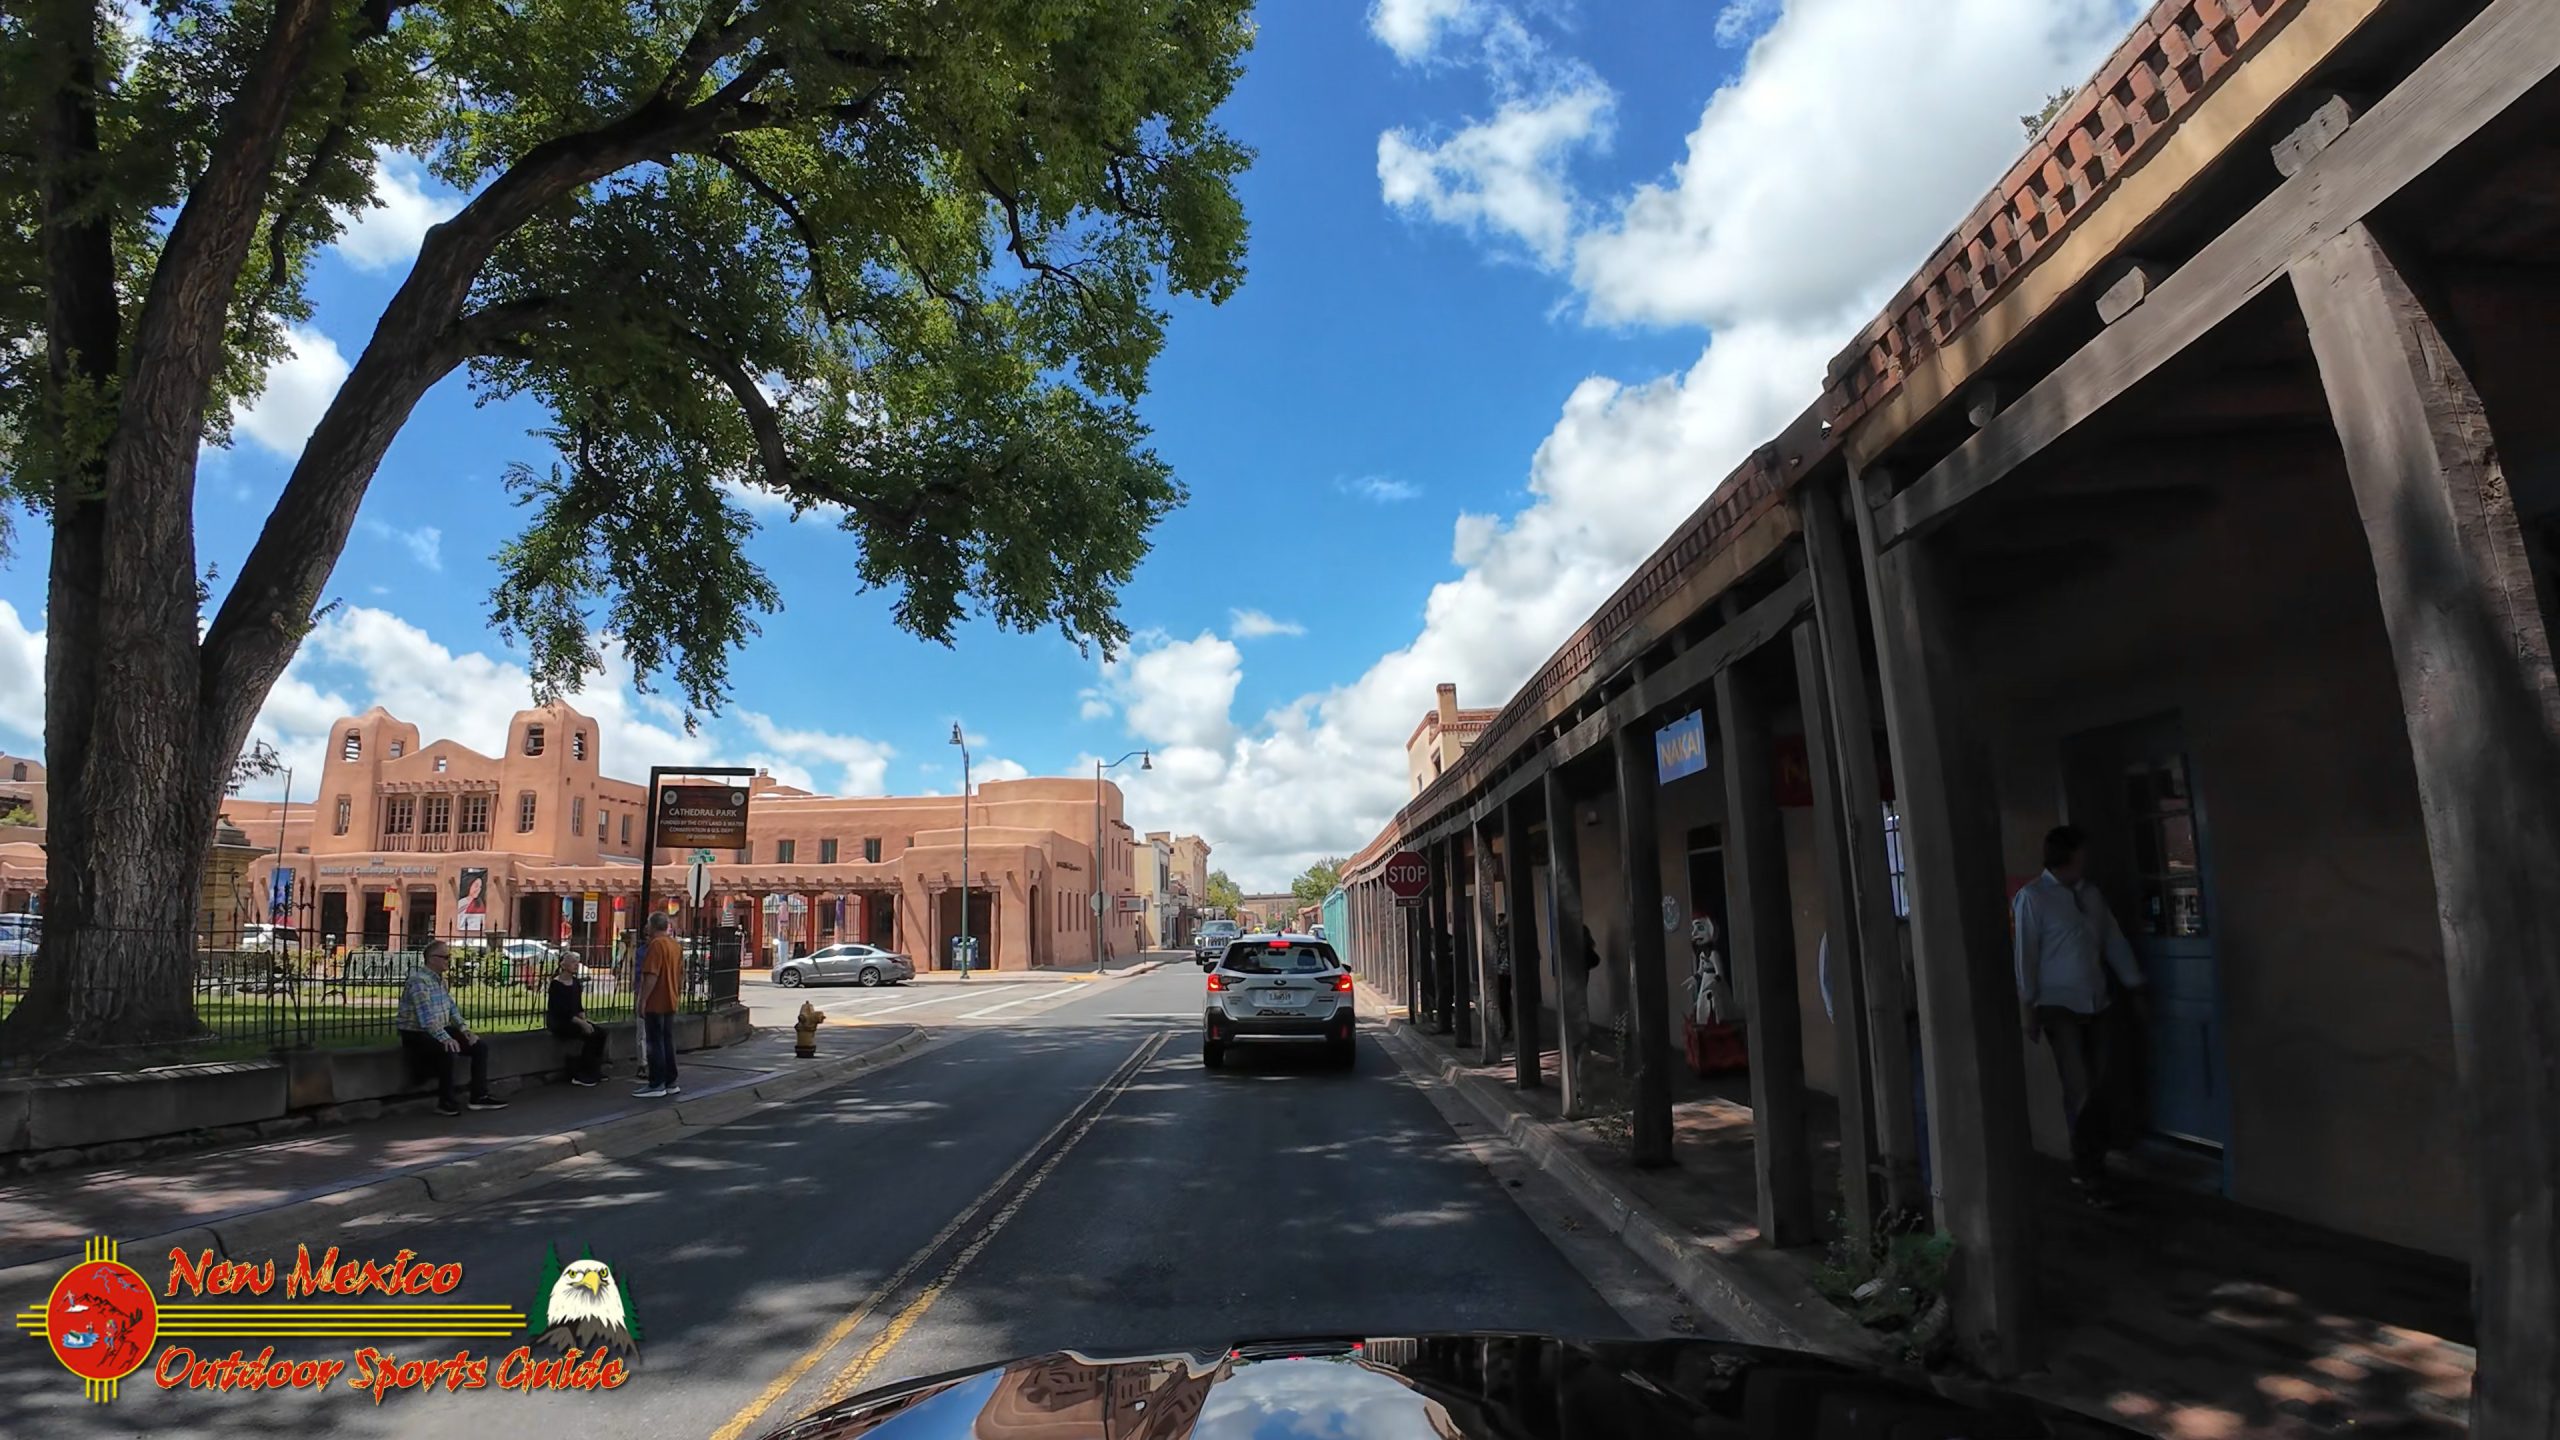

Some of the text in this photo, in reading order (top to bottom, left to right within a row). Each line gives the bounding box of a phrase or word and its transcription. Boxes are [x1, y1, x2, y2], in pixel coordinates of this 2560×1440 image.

[1661, 728, 1701, 768] NAKAI
[669, 808, 737, 817] CATHEDRAL PARK
[1389, 866, 1427, 883] STOP
[585, 911, 596, 919] 20
